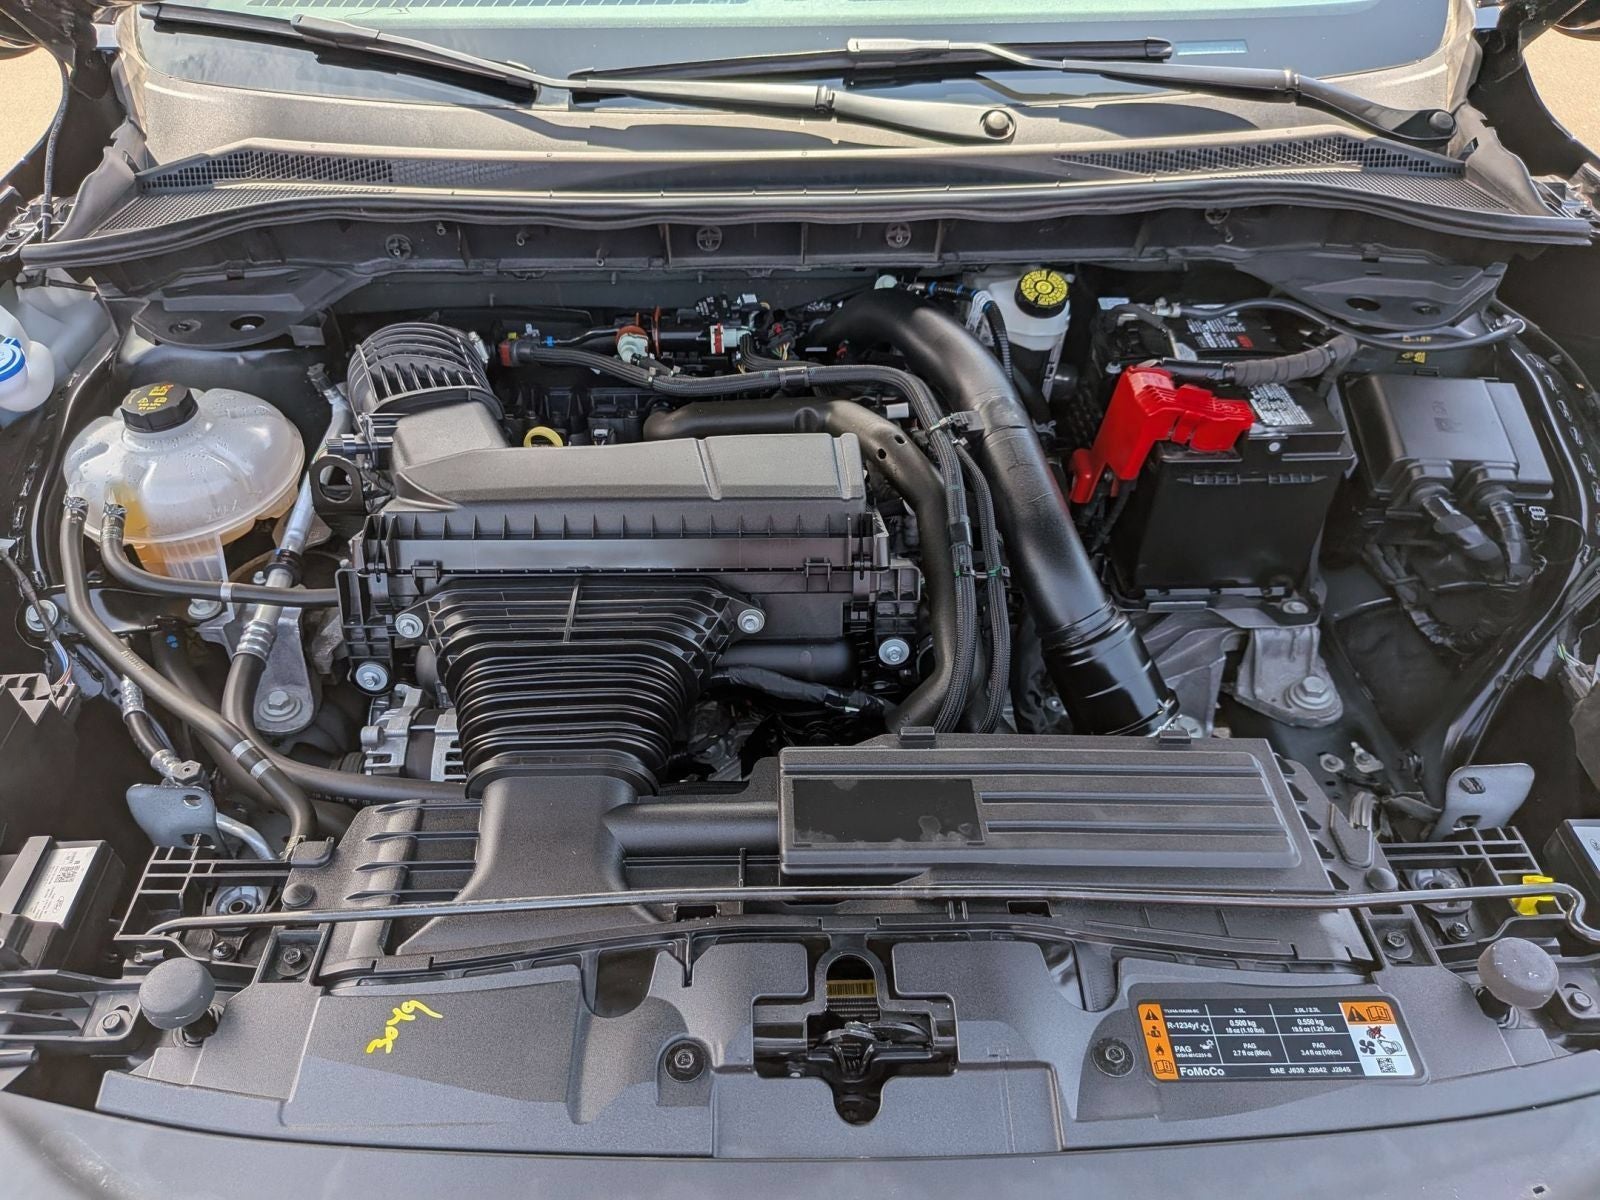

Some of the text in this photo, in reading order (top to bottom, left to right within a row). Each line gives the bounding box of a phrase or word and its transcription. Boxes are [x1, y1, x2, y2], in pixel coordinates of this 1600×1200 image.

[1246, 1020, 1256, 1028] kg
[1314, 1018, 1324, 1026] kg
[1166, 1022, 1199, 1031] R-1234yf
[1180, 1066, 1225, 1076] FoMoCo
